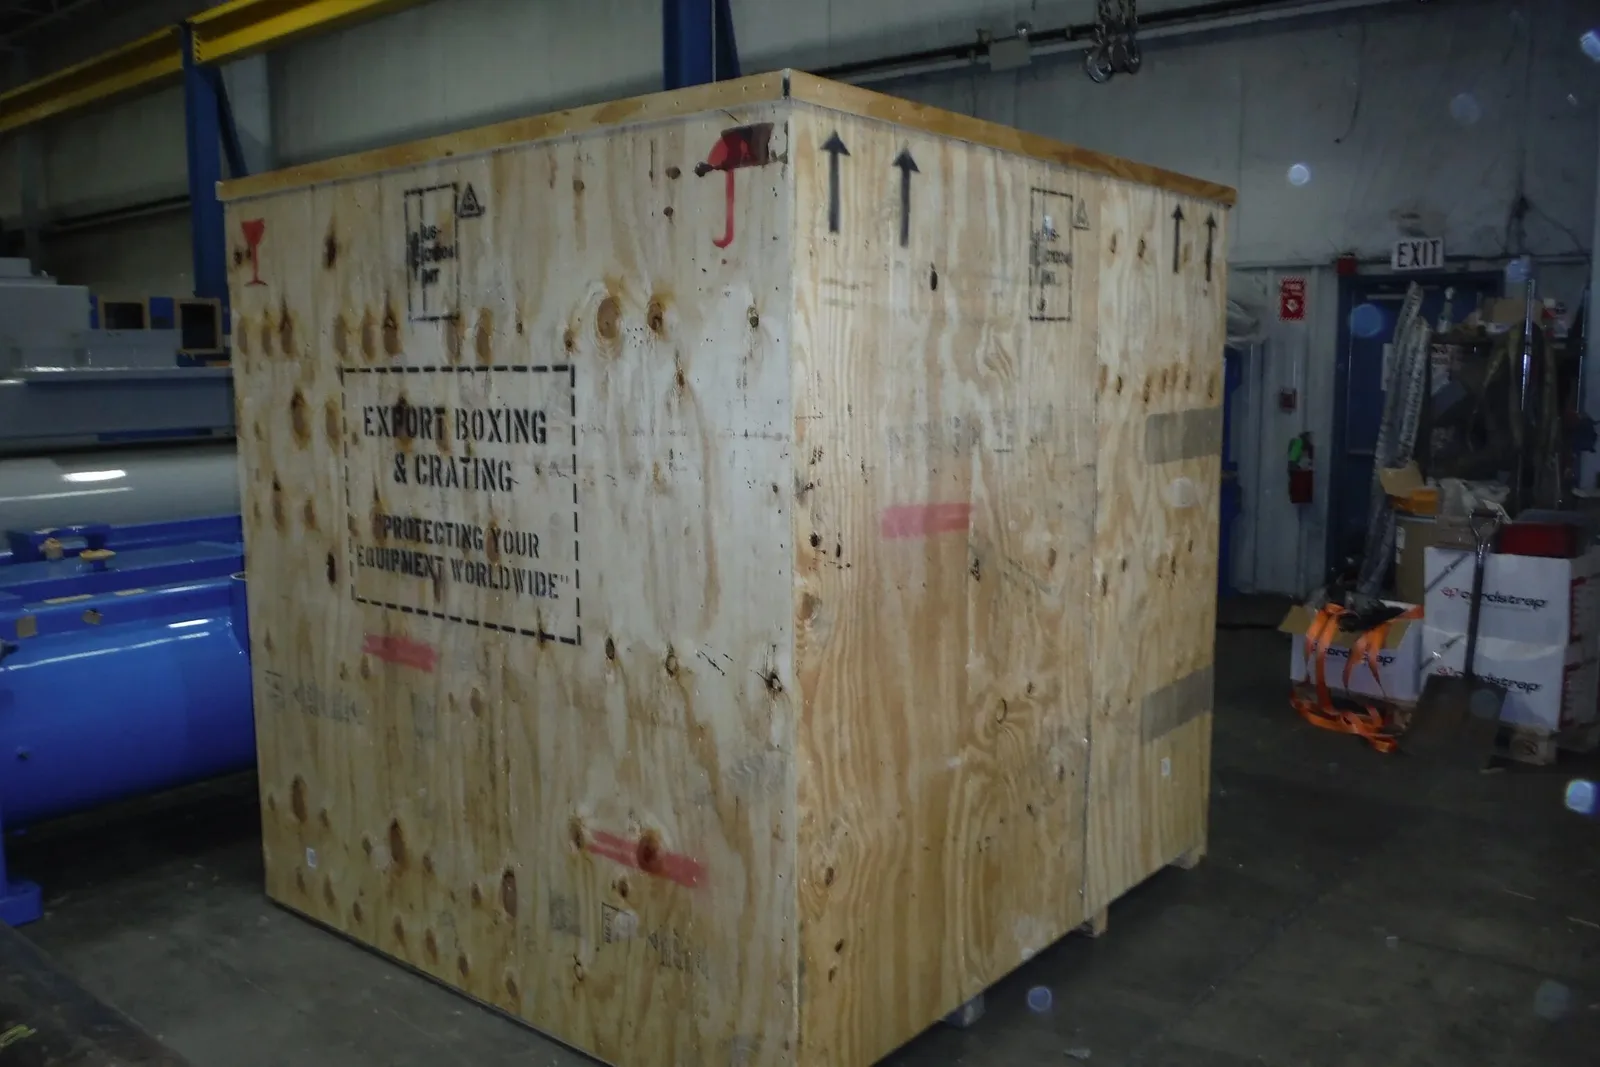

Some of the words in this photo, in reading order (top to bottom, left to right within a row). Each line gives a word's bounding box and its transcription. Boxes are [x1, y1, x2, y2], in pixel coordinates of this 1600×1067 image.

[1398, 239, 1441, 267] EXIT
[363, 405, 446, 441] EXPORT
[455, 407, 547, 445] BOXING
[394, 452, 407, 485] &
[415, 454, 513, 493] CRATING
[491, 527, 541, 559] YOUR
[356, 545, 445, 578] EQUIPMENT
[1460, 591, 1547, 611] crdstrap
